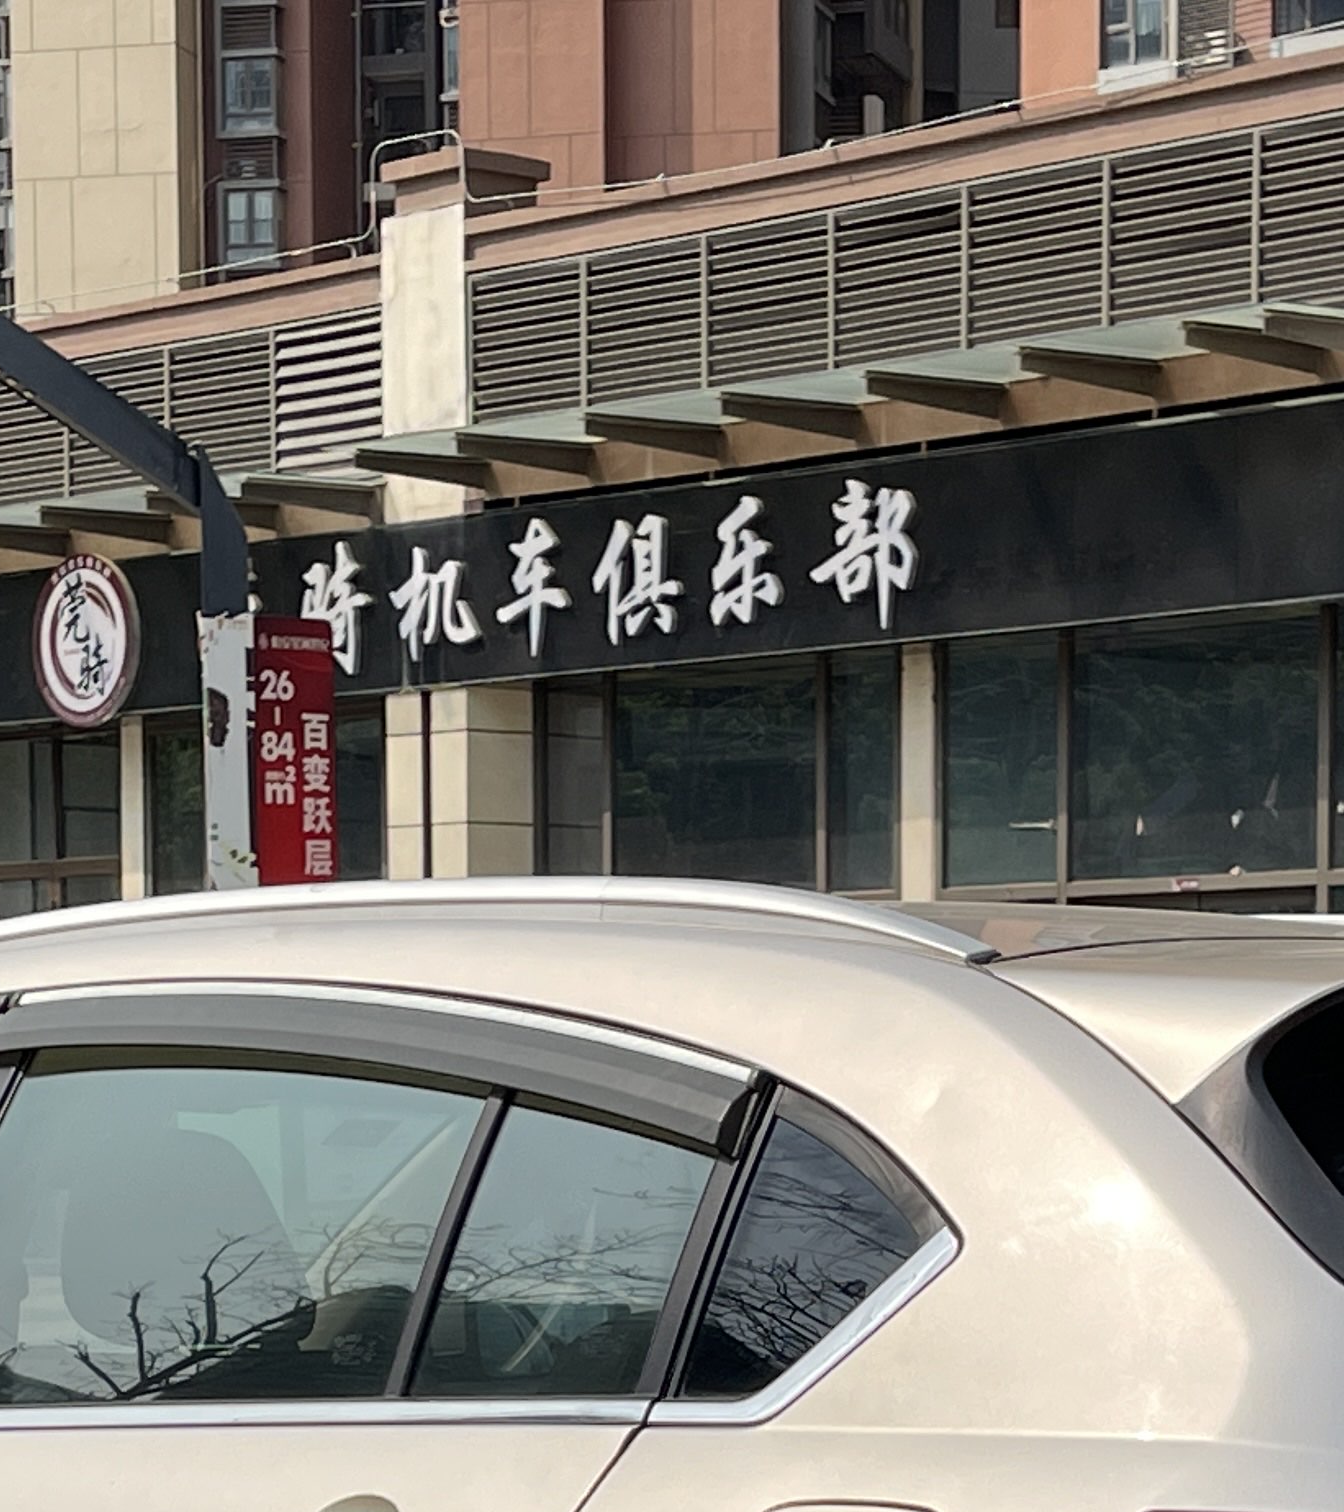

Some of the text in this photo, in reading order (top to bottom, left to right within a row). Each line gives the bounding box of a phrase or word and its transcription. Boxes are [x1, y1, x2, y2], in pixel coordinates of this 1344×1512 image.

[247, 479, 919, 676] 骑机车俱乐部
[259, 669, 296, 702] 26
[260, 731, 297, 763] 84
[300, 711, 334, 877] 百变跃层
